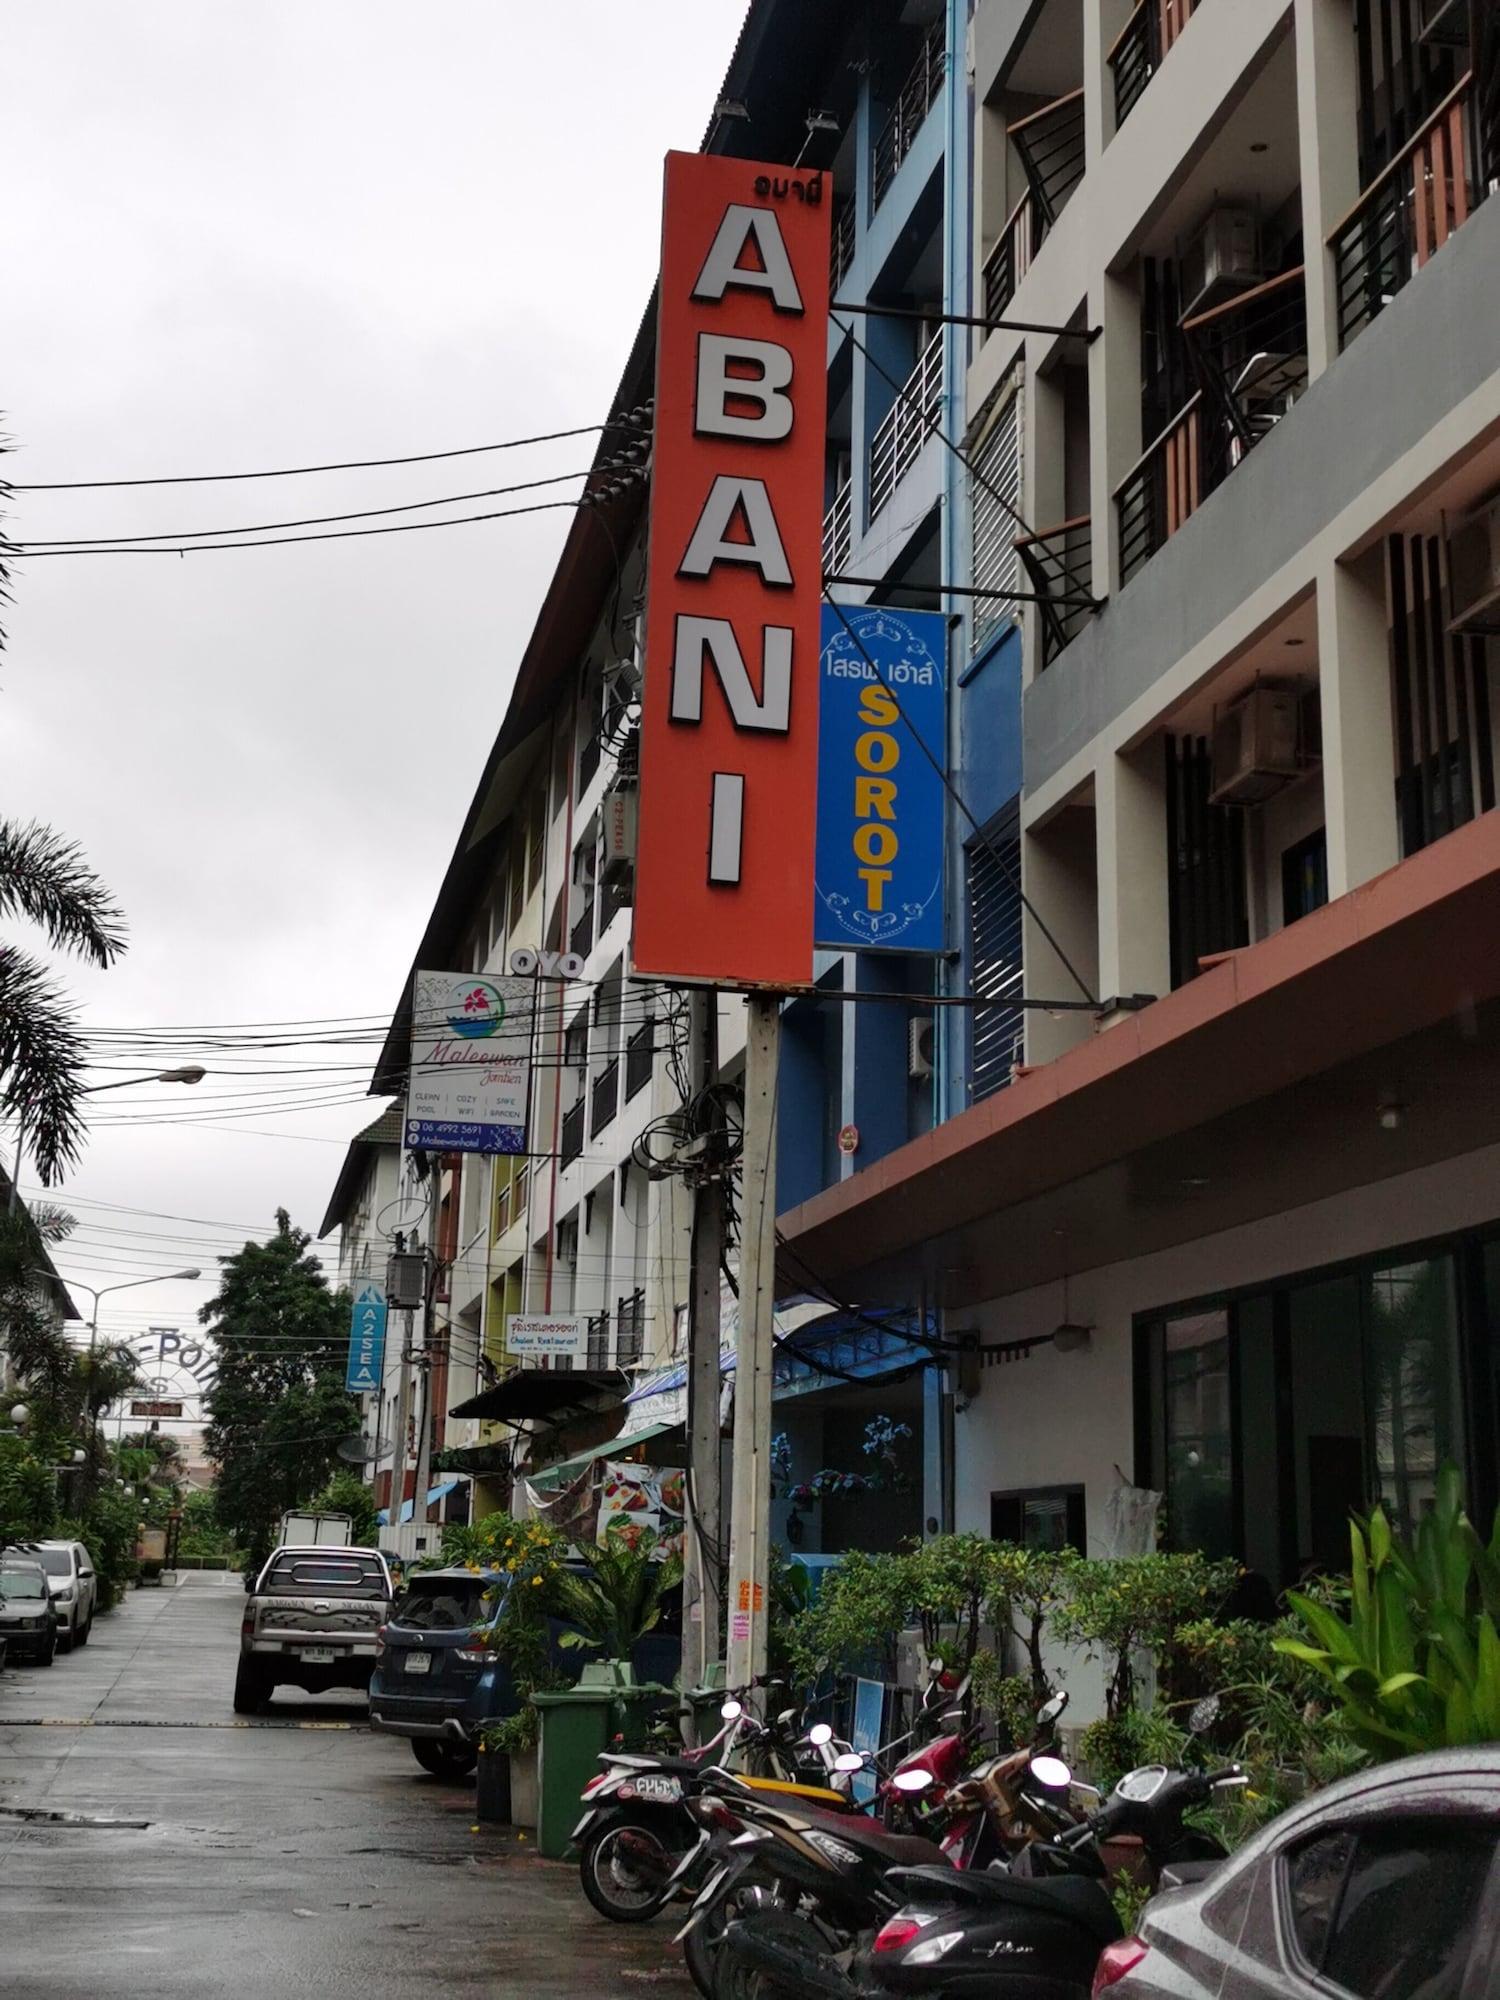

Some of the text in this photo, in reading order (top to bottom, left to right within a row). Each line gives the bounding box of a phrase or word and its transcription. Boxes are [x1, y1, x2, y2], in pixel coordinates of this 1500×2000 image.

[669, 203, 804, 886] ABANI
[853, 684, 900, 912] SOROT
[423, 1036, 525, 1067] Maleewan
[415, 1092, 440, 1101] CLEAN
[456, 1095, 477, 1104] COZY
[416, 1105, 436, 1114] POOL
[422, 1123, 434, 1132] 06
[357, 1308, 377, 1379] A2SEA
